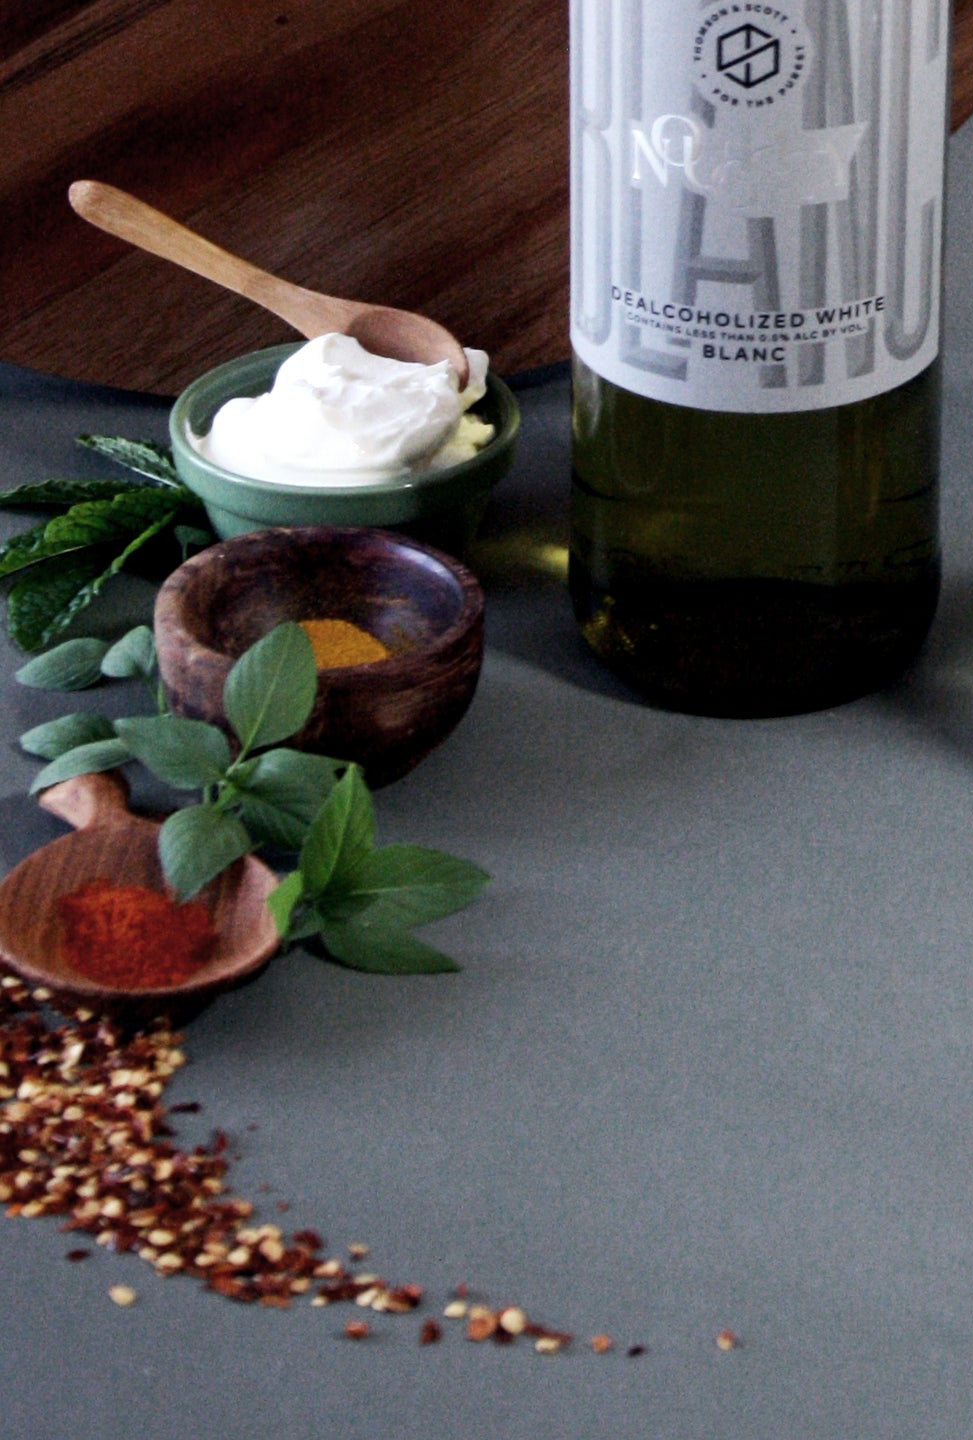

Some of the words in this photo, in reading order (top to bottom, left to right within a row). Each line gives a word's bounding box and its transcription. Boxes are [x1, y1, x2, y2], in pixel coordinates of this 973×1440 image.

[693, 6, 728, 62] THOMSON
[745, 3, 788, 23] SCOTT
[712, 87, 739, 106] FOR
[746, 96, 775, 108] THE
[611, 285, 805, 329] DEALCOHOLIZED
[815, 296, 885, 325] WHITE
[626, 311, 682, 334] CONTAINS
[685, 327, 717, 340] LESS
[721, 331, 755, 341] THAN
[794, 330, 819, 341] ALC
[822, 328, 837, 338] BY
[702, 344, 785, 362] BLANC
